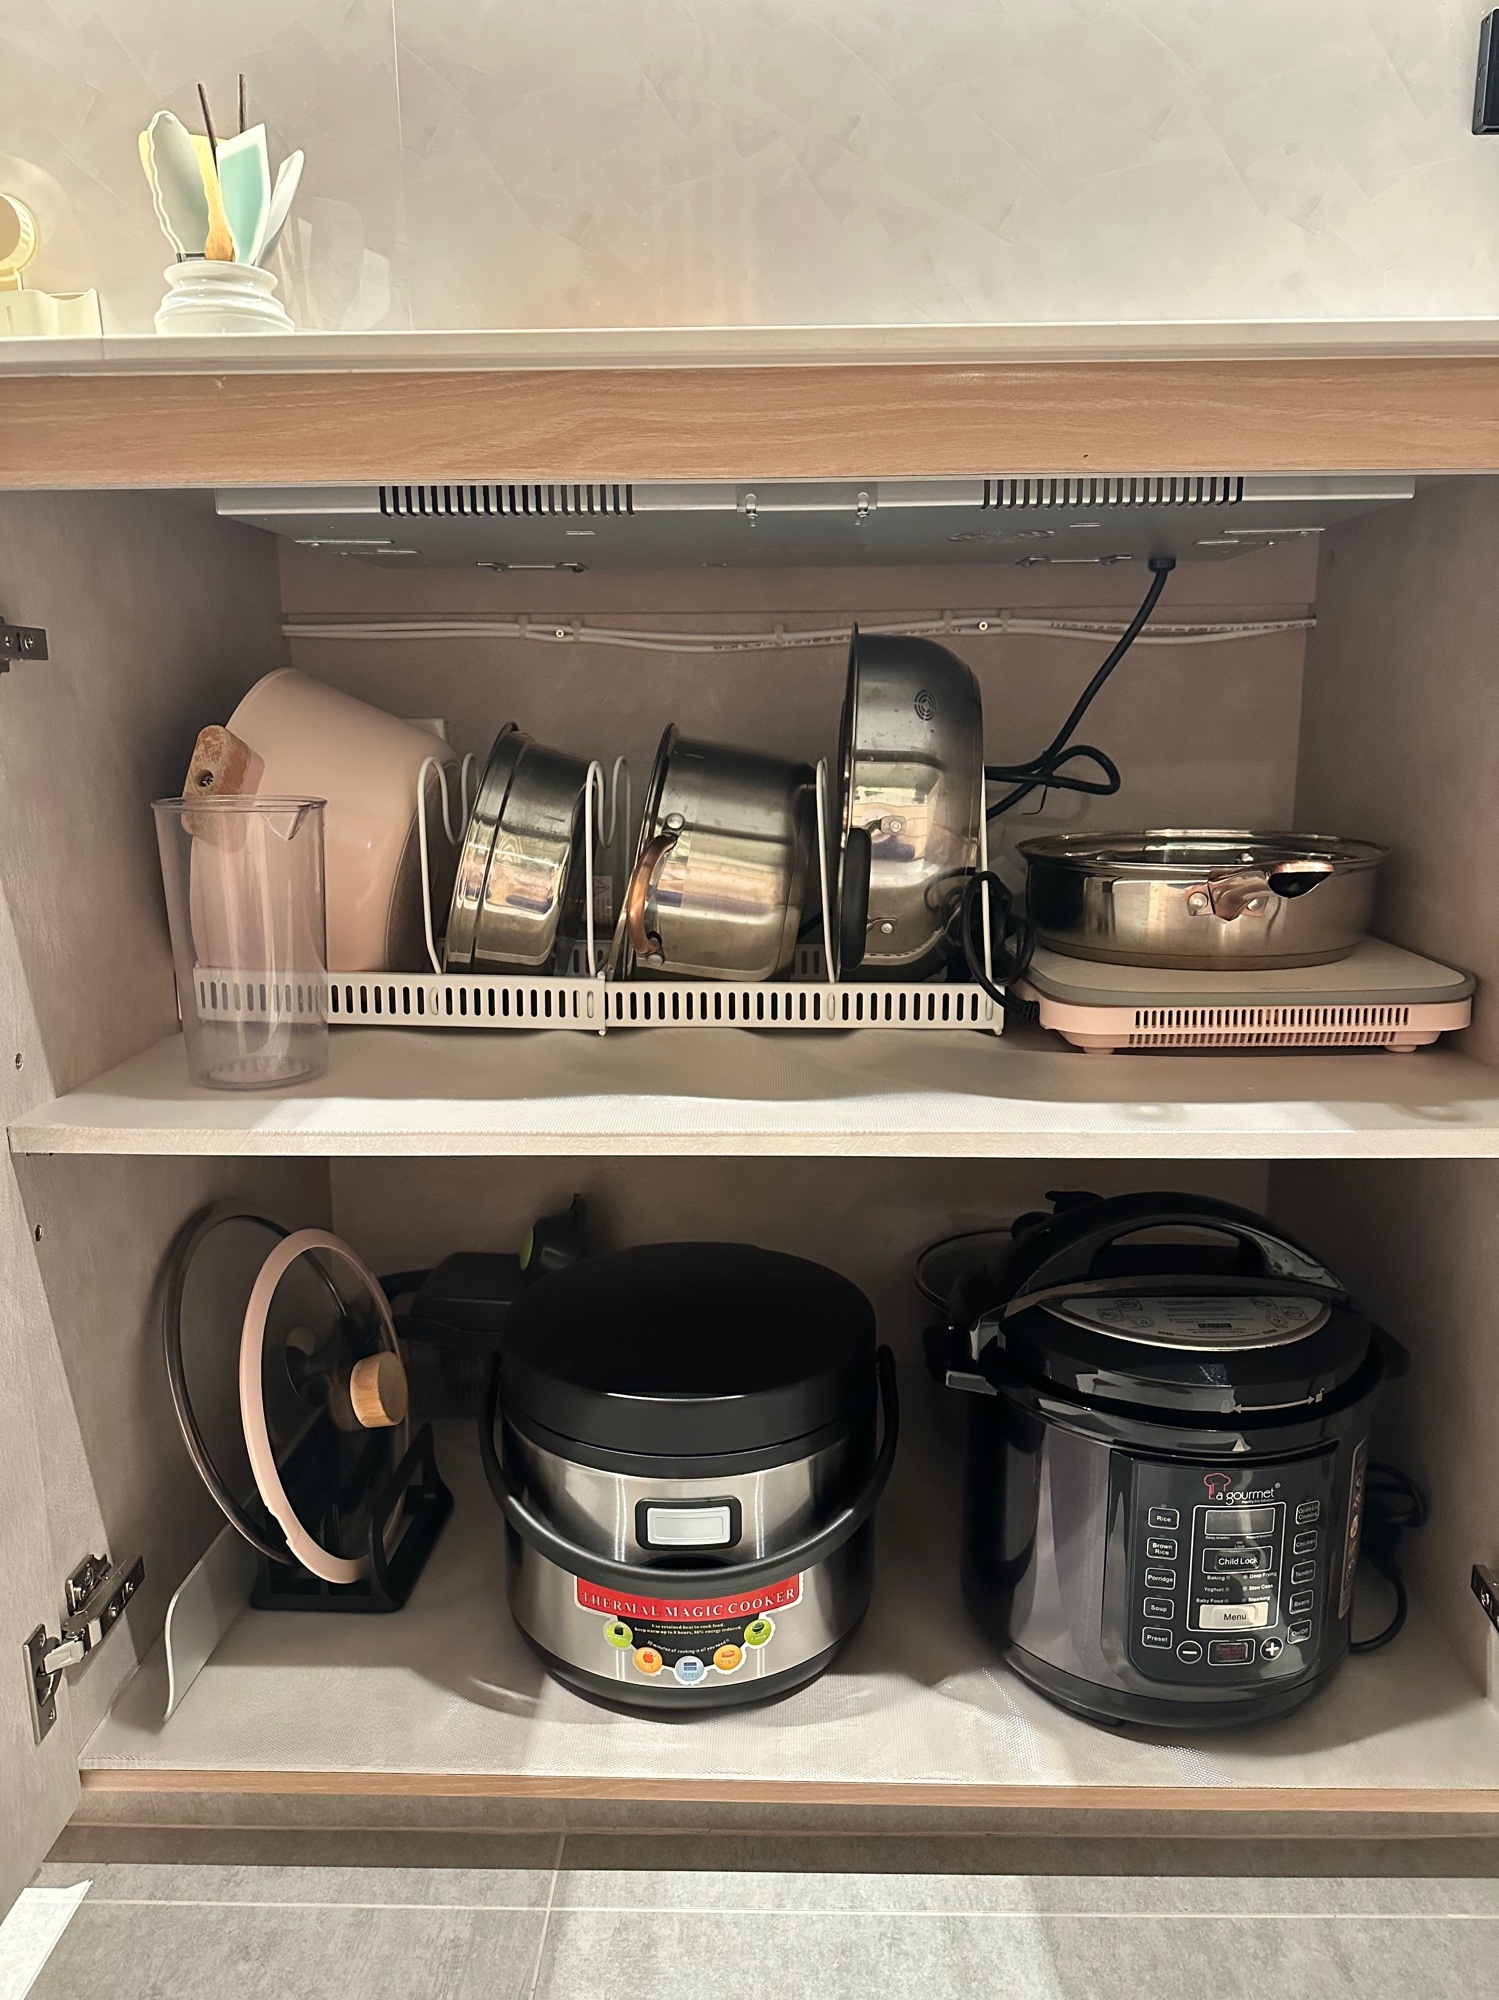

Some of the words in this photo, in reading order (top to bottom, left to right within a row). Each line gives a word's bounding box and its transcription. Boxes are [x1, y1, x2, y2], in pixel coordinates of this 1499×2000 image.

[1225, 1487, 1275, 1506] gourmet
[1156, 1515, 1172, 1523] Rice
[1152, 1542, 1173, 1550] Brown
[1218, 1557, 1239, 1566] Child
[1240, 1557, 1259, 1565] Lock
[1147, 1574, 1174, 1583] Porridge
[581, 1591, 660, 1616] THERMAL
[665, 1605, 723, 1617] MAGIC
[727, 1588, 795, 1614] COOKER
[1150, 1604, 1168, 1613] Soup
[1223, 1613, 1247, 1621] Menu
[1146, 1634, 1168, 1643] Preset
